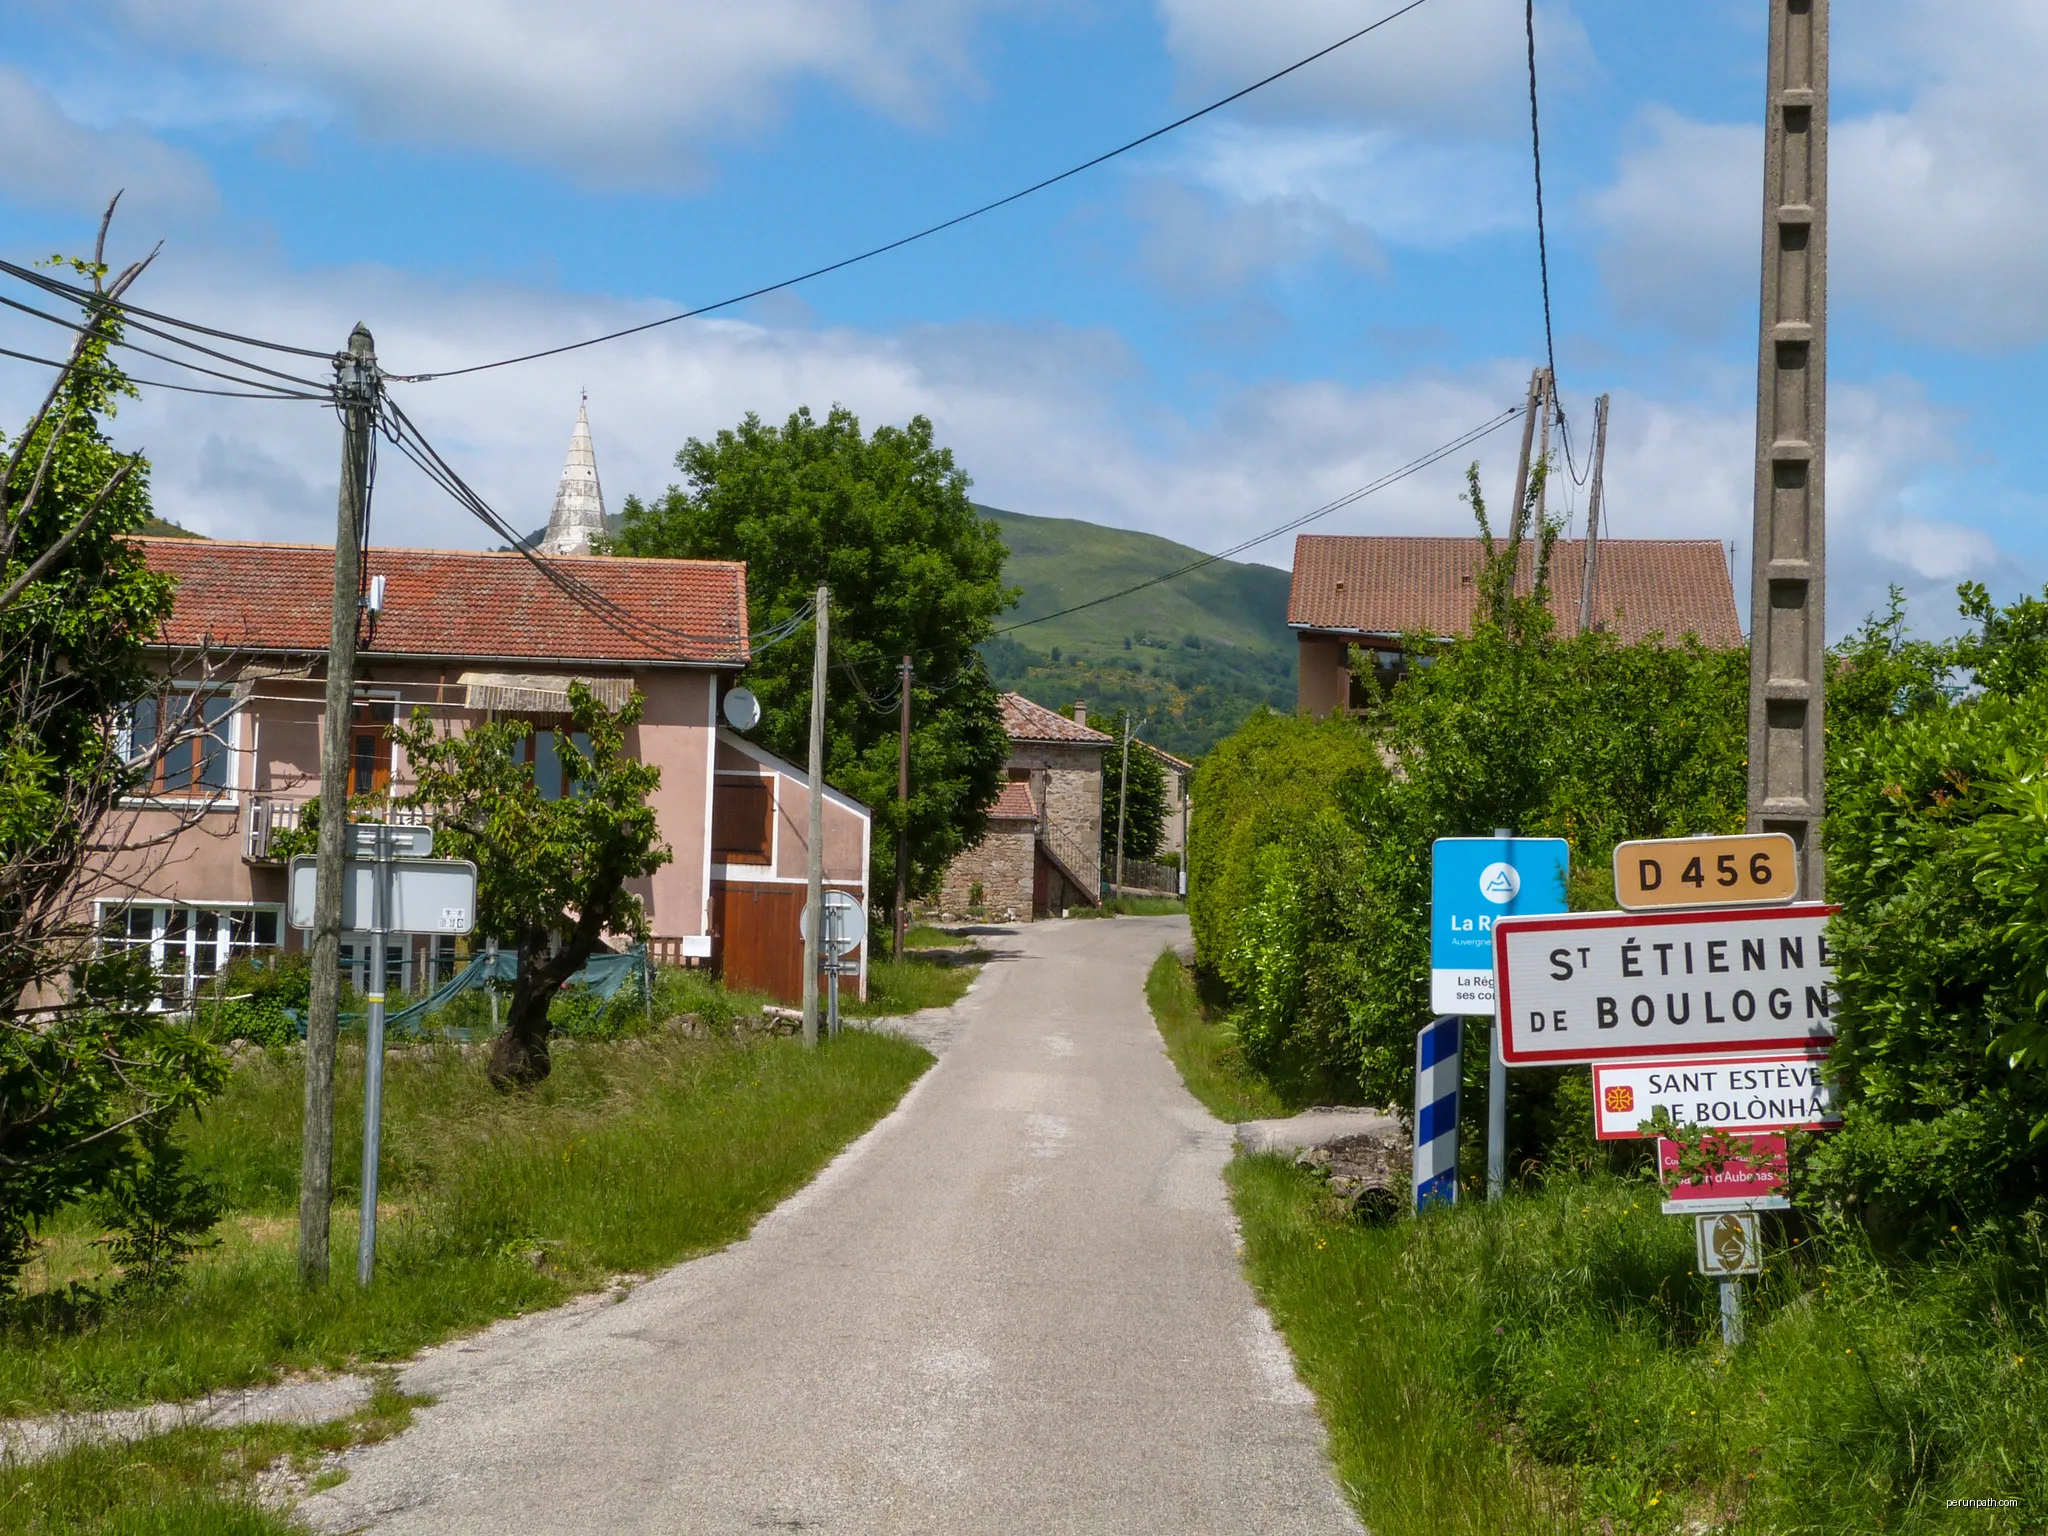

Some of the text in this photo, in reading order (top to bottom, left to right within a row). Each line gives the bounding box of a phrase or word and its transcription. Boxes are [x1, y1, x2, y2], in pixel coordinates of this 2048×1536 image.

[1639, 852, 1773, 891] D 456
[1451, 914, 1492, 931] La R
[1457, 977, 1470, 986] La
[1456, 992, 1495, 1000] ses co
[1530, 985, 1829, 1033] DE BOULOGN
[1649, 1064, 1824, 1094] SANT ESTÈVE
[1696, 1095, 1825, 1122] BOLÒNHA
